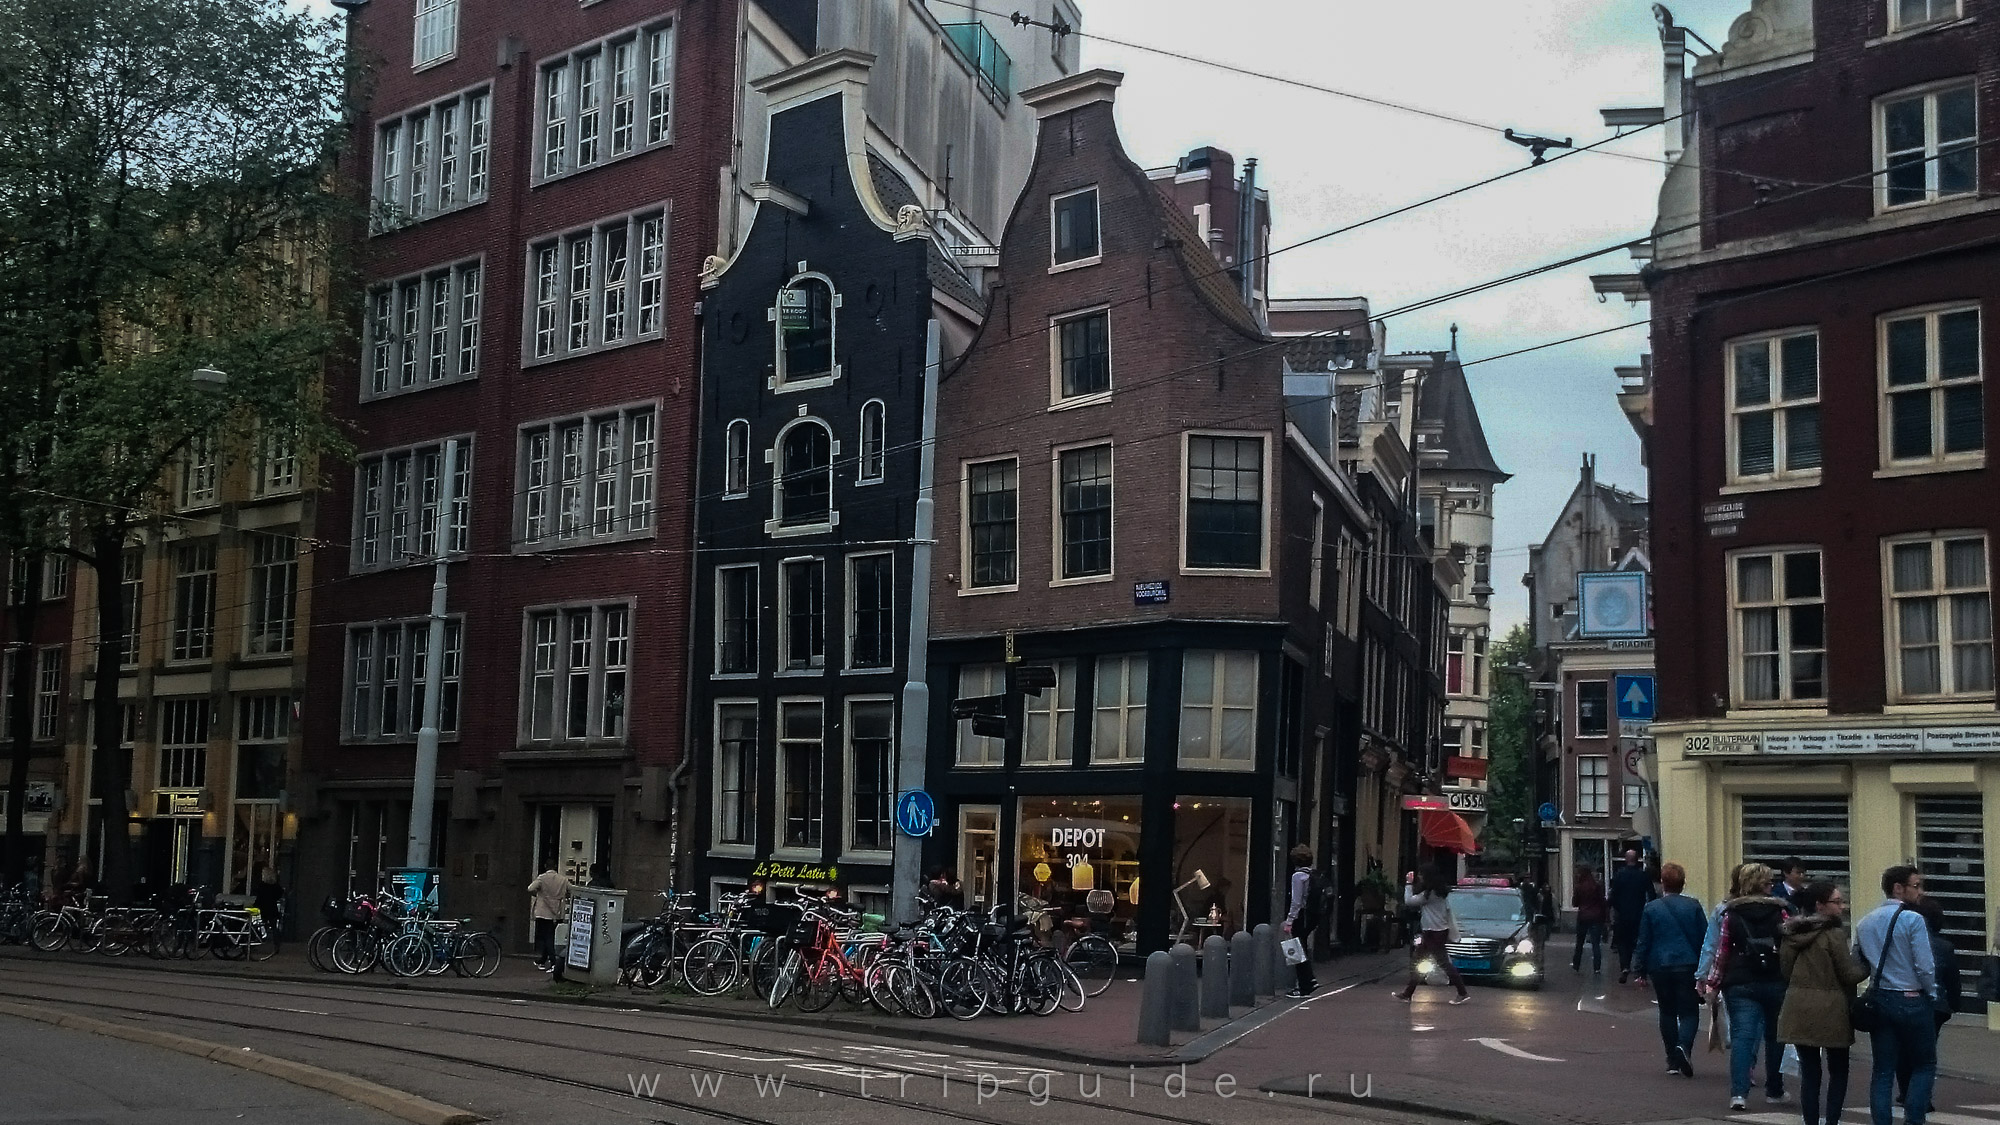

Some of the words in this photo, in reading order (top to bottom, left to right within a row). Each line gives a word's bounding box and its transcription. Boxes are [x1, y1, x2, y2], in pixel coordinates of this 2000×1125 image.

[1685, 737, 1710, 751] 302
[1712, 735, 1760, 744] BULTERMAN
[1799, 734, 1827, 742] Verkoop
[1052, 828, 1106, 848] DEPOT
[1065, 853, 1089, 869] 304
[752, 861, 768, 877] Le
[769, 862, 796, 878] Petit
[796, 863, 826, 880] Latin
